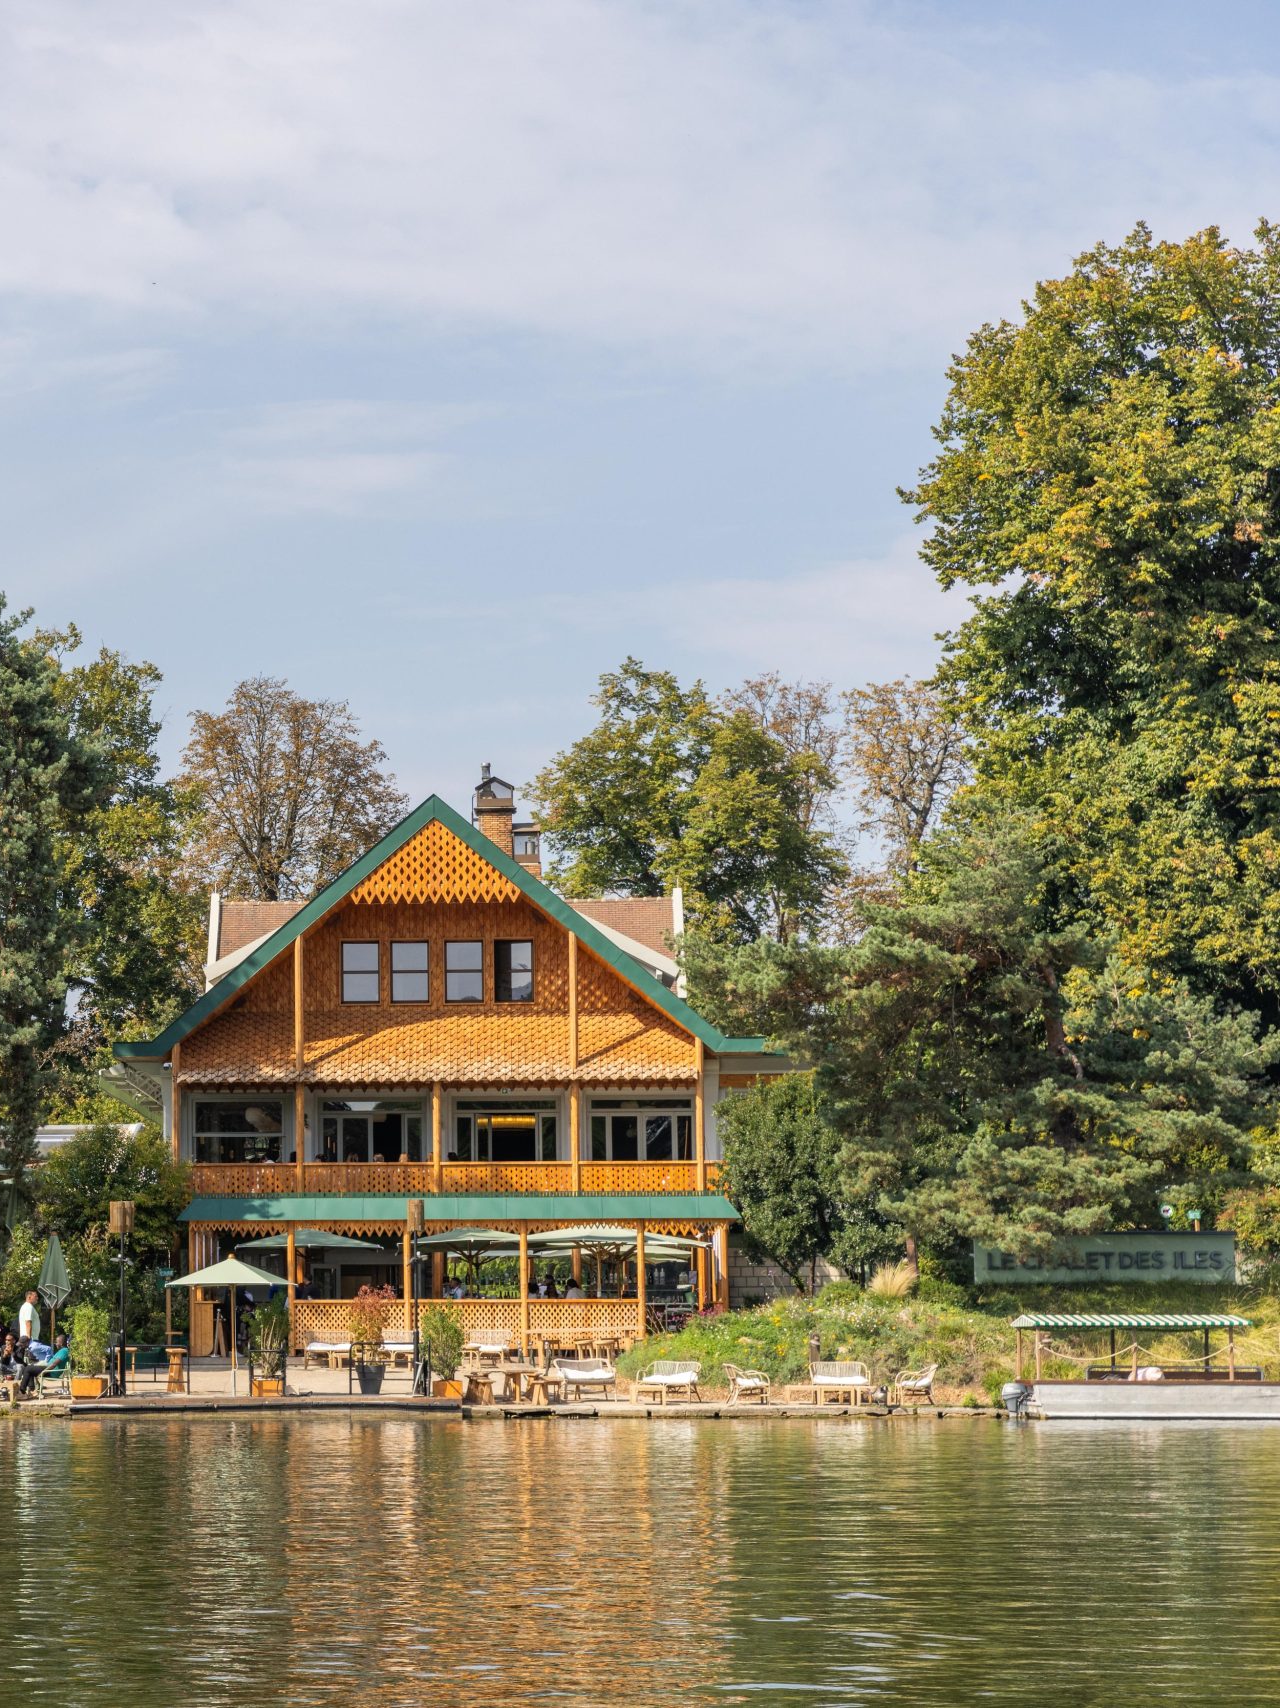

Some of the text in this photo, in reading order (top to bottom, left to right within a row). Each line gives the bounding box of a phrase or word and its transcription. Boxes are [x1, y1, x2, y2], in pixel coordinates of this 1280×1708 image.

[987, 1252, 1015, 1271] LE
[1119, 1251, 1165, 1270] DES
[1173, 1250, 1224, 1270] ILES
